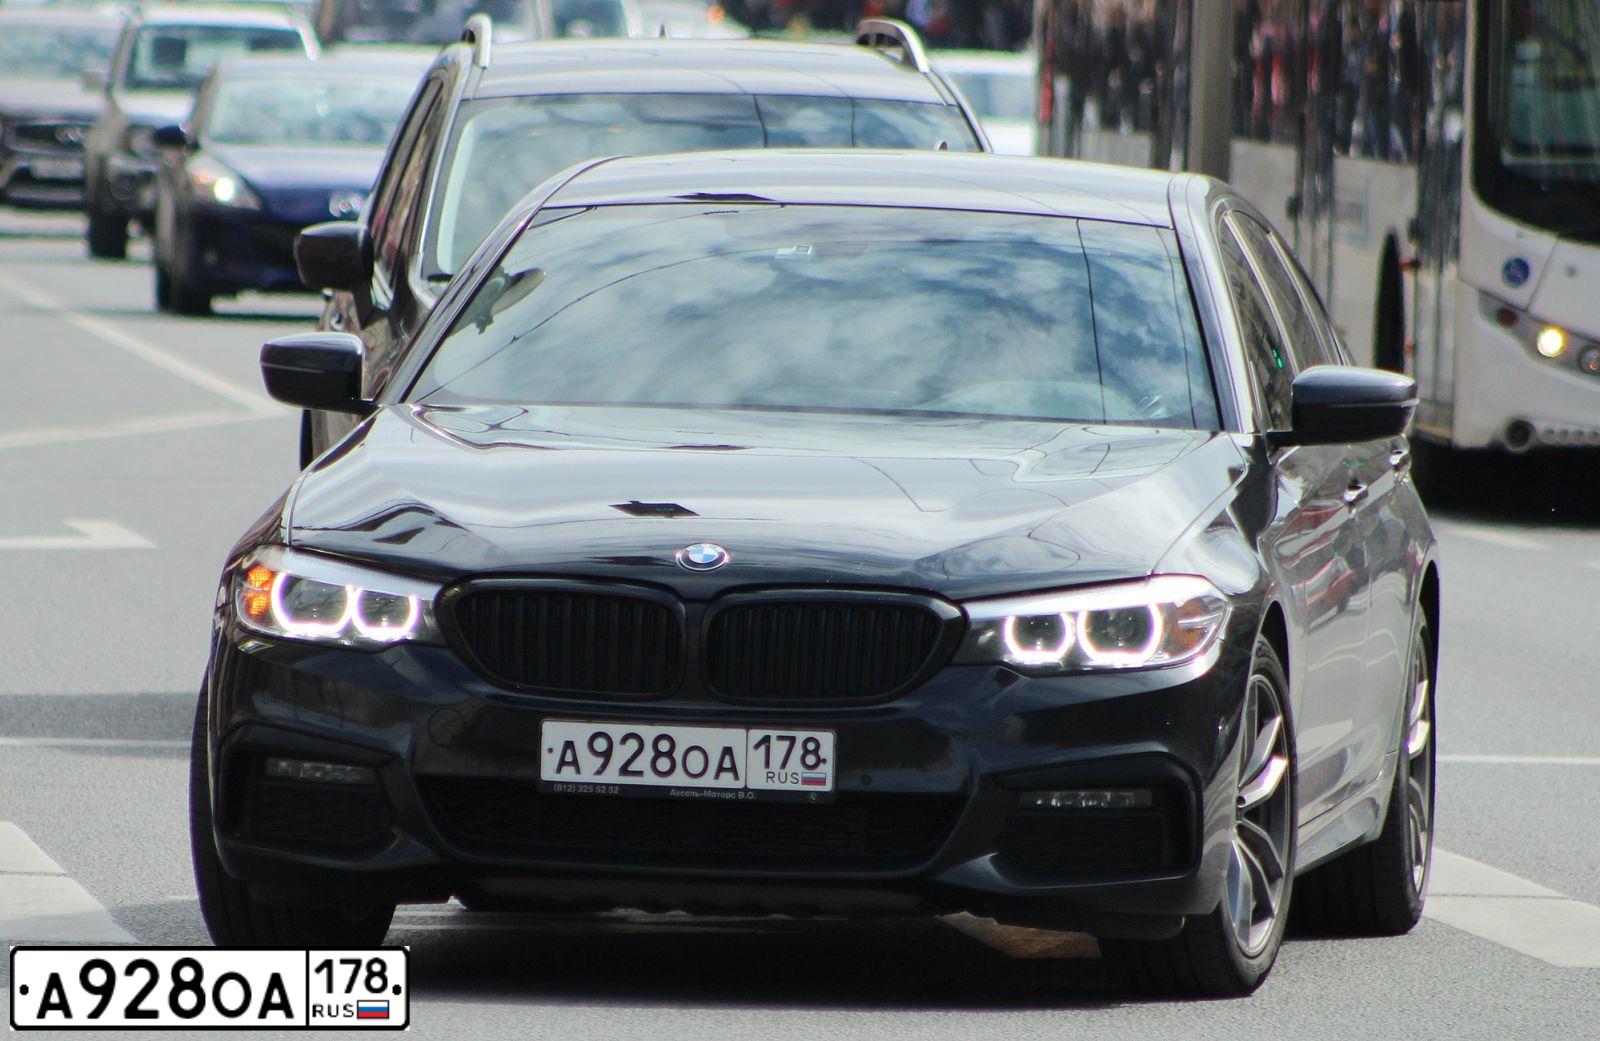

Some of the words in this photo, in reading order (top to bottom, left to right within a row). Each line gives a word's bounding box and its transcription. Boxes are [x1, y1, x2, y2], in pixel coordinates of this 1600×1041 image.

[753, 735, 821, 771] 178
[765, 771, 799, 784] RUS
[595, 785, 607, 794] 52
[608, 786, 619, 794] 52
